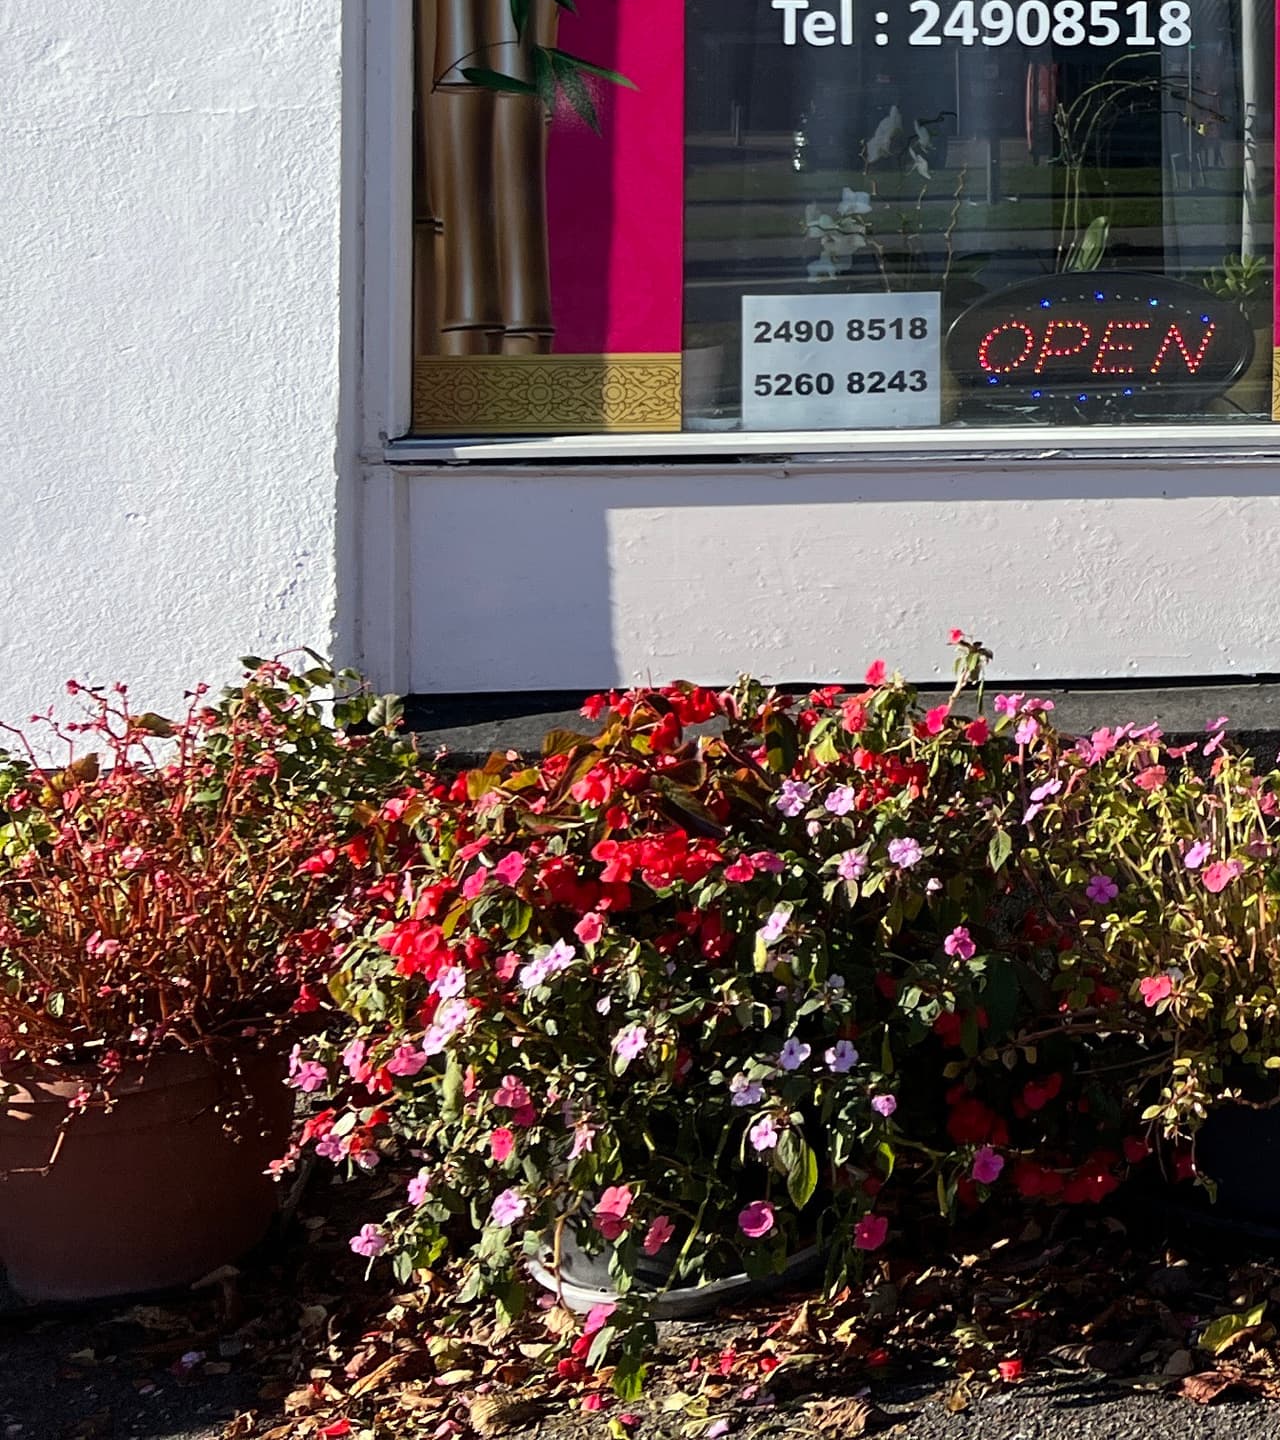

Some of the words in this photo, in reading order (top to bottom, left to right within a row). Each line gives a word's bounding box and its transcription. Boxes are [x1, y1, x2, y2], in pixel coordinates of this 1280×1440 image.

[907, 0, 1192, 47] 24908518
[753, 319, 835, 344] 2490
[846, 317, 928, 342] 8518
[978, 320, 1216, 374] OPEN
[753, 372, 835, 397] 5260
[846, 370, 928, 395] 8243
